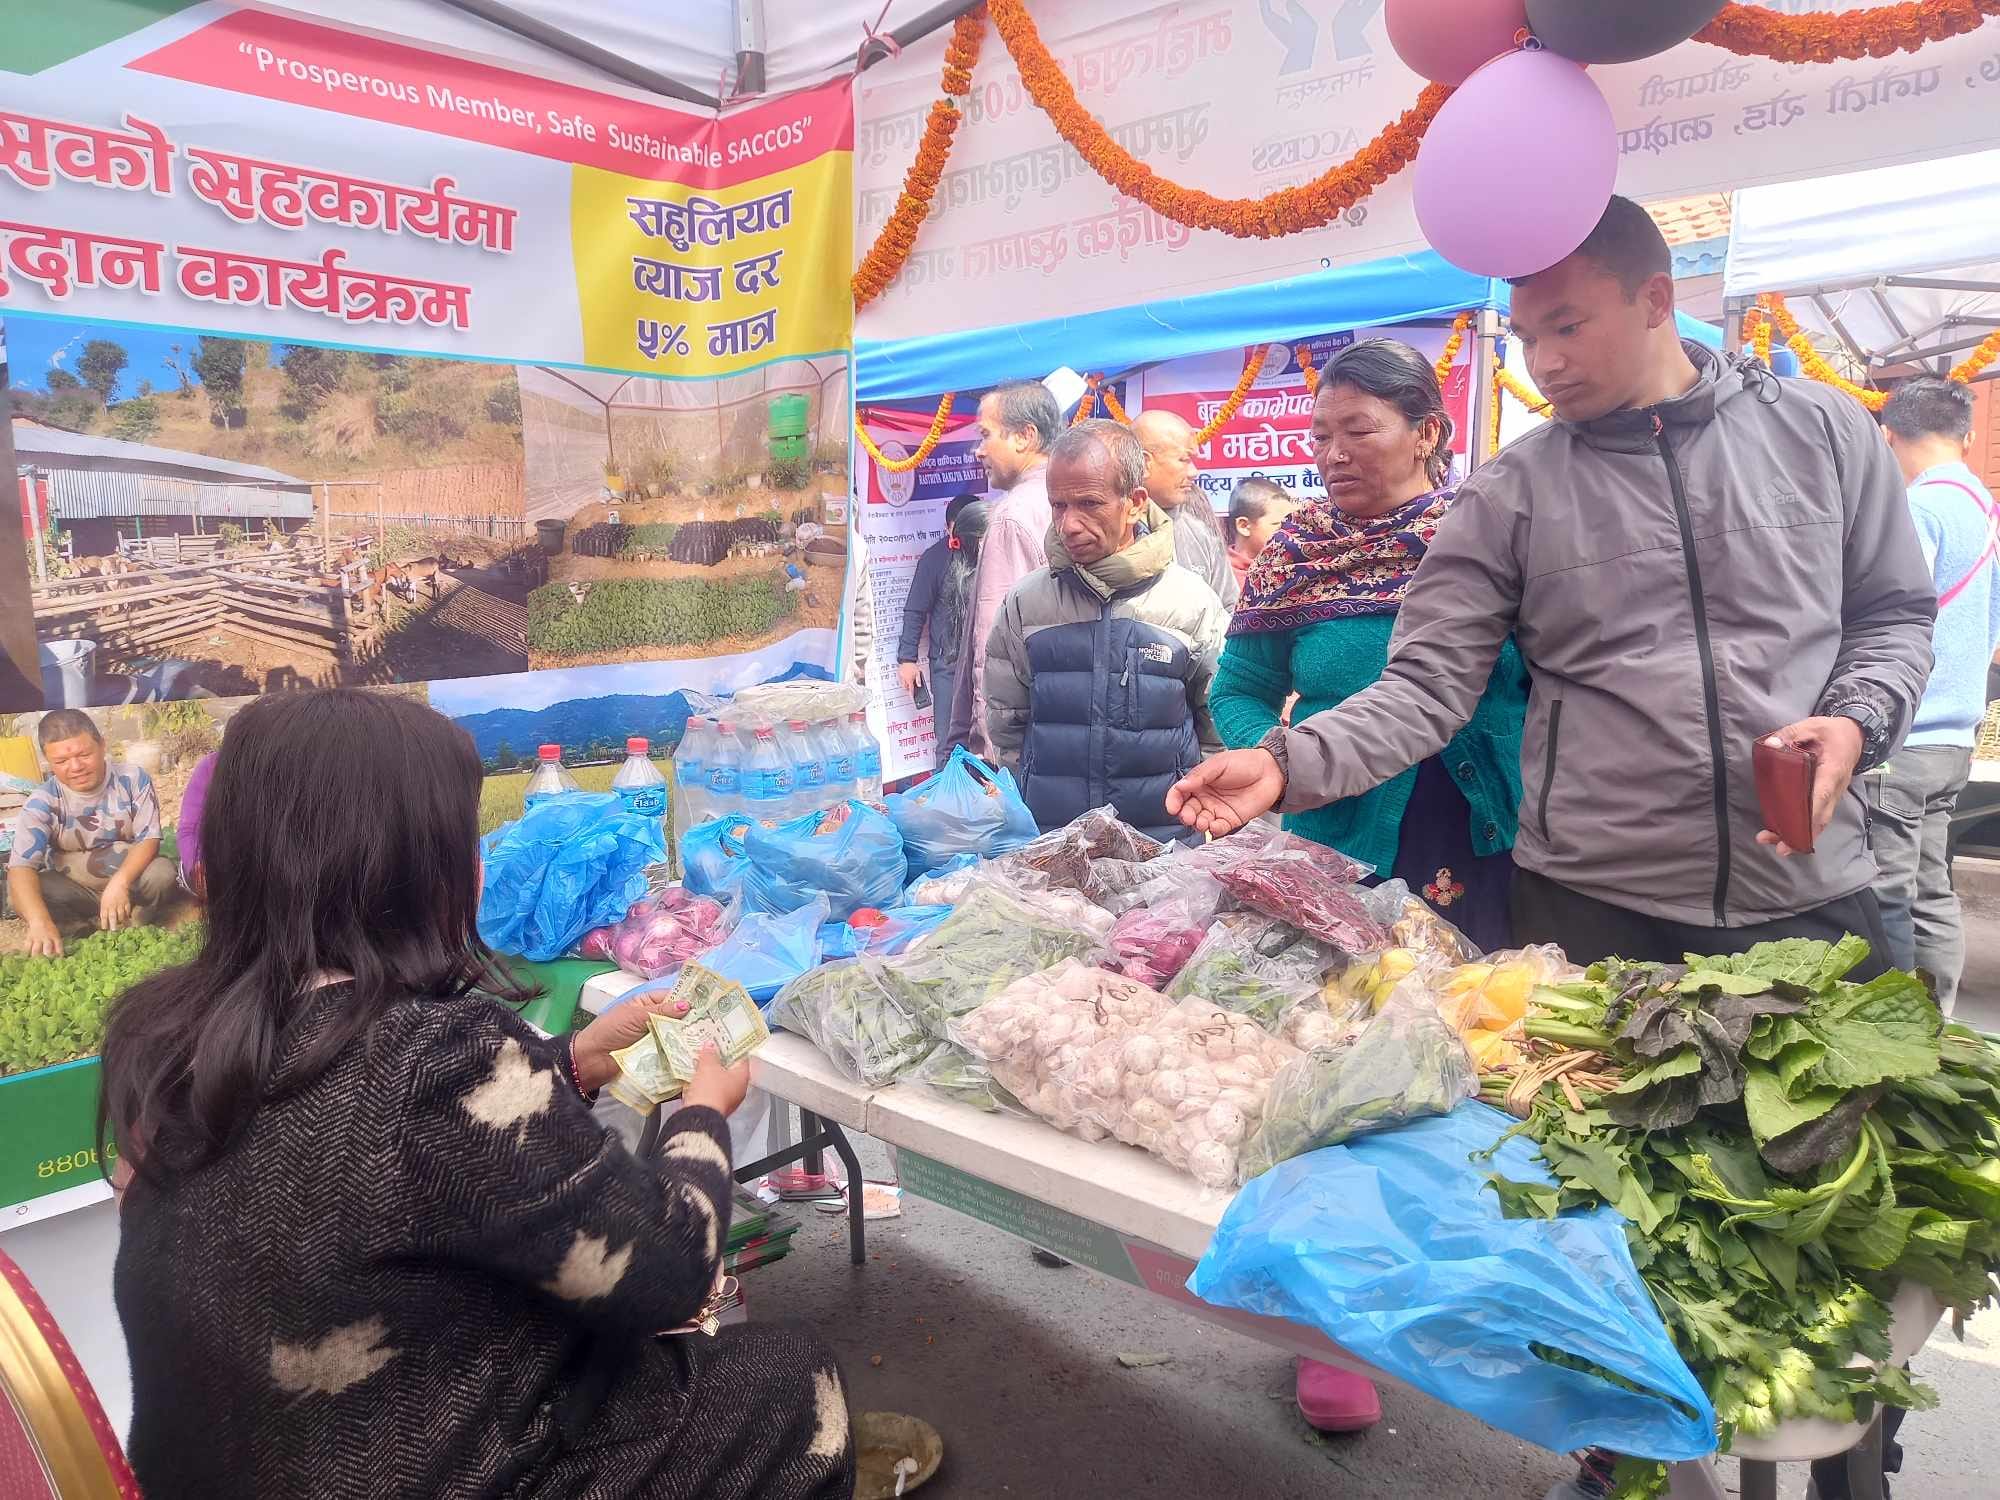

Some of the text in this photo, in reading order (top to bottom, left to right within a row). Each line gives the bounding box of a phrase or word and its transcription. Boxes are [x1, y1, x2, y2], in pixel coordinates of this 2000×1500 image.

[426, 84, 542, 134] Member,
[547, 111, 597, 142] Safe
[607, 124, 723, 168] Sustainable
[186, 145, 519, 252] सहकार्यमा
[627, 188, 793, 252] सहुलियत
[176, 245, 473, 330] कार्यक्रम
[733, 249, 784, 295] दर
[706, 308, 777, 357] मात्र
[1138, 647, 1161, 656] NORTH
[1144, 653, 1162, 662] FACE
[1149, 642, 1163, 650] THE
